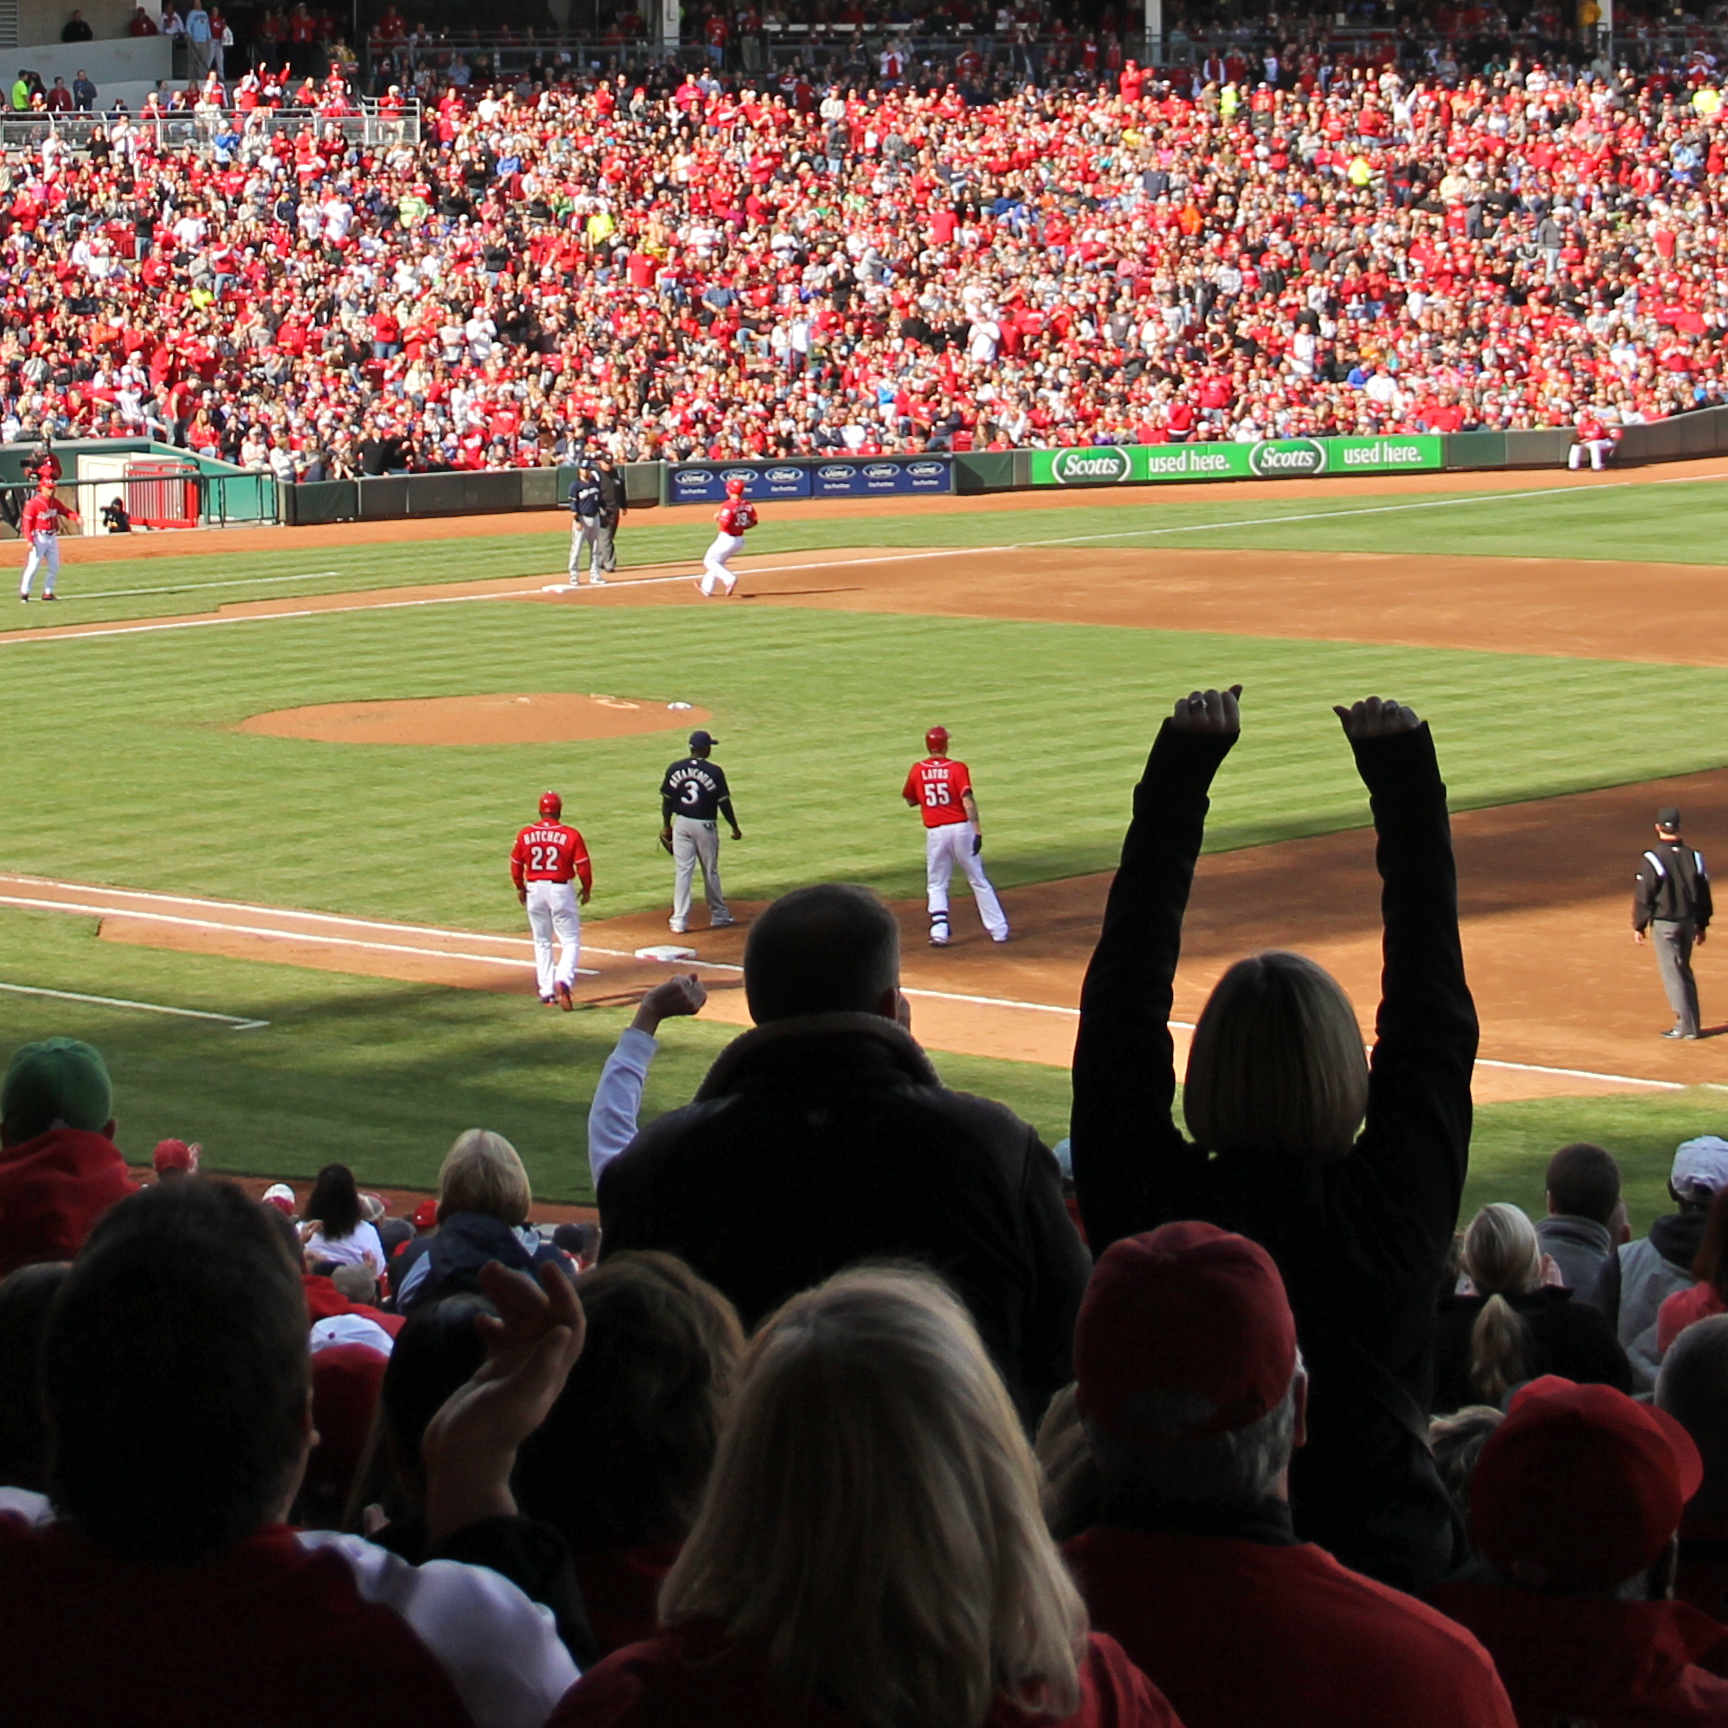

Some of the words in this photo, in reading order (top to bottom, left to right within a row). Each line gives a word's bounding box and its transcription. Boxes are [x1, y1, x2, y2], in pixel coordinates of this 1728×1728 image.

[1149, 454, 1188, 473] used
[1190, 450, 1231, 472] here.
[1260, 446, 1315, 470] Scotts
[1343, 446, 1380, 465] used
[1382, 441, 1423, 463] here.
[1064, 454, 1121, 478] Scotts
[921, 768, 949, 780] LATOS
[681, 780, 700, 804] 3
[924, 783, 950, 807] 55
[523, 830, 568, 845] HATCHER
[531, 846, 559, 871] 22
